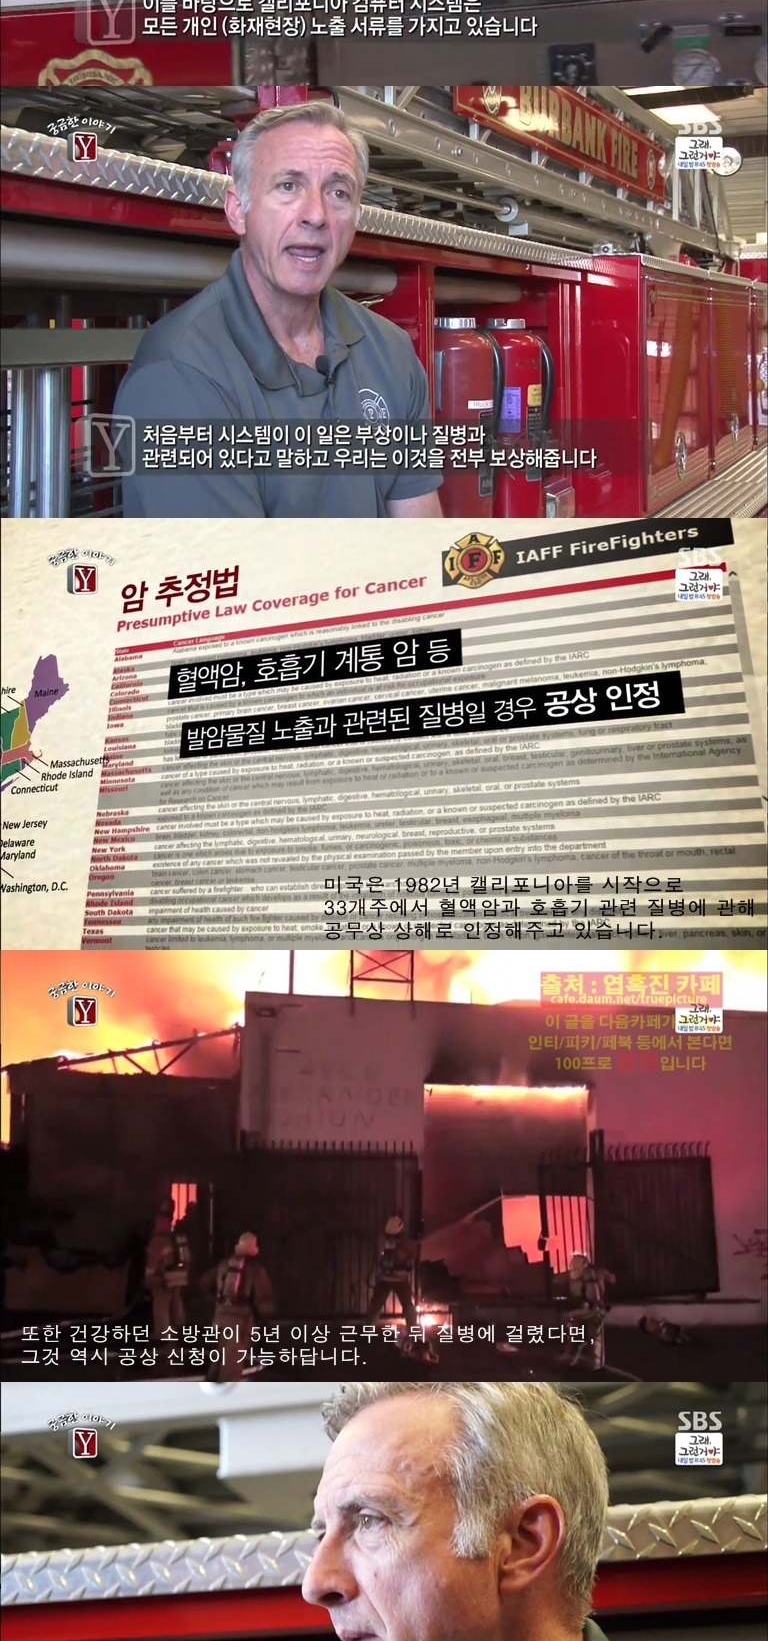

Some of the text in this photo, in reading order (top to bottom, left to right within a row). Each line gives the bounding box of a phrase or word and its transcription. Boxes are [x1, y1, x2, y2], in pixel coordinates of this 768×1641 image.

[519, 86, 639, 178] BURBANK FIRE
[516, 525, 699, 565] IAFF FireFighters
[120, 565, 240, 614] 암 추정법
[116, 576, 428, 632] Presumptive Law Coverage for Cancer
[114, 654, 143, 663] Alabama
[34, 688, 59, 698] Maine
[110, 689, 140, 698] Colorado
[104, 743, 137, 752] Louisiana
[50, 755, 110, 769] Massachusetts
[41, 768, 94, 782] Rhode Island
[11, 783, 59, 795] Connecticut
[577, 796, 609, 806] defined
[622, 795, 636, 803] the
[638, 793, 661, 802] IARC
[96, 810, 130, 818] Nebraska
[3, 819, 48, 830] New Jersey
[112, 826, 151, 836] Hampshire
[51, 881, 69, 891] D.C.
[86, 889, 135, 899] Pennsylvania
[84, 908, 134, 917] South Dakota
[83, 928, 104, 936] Texas
